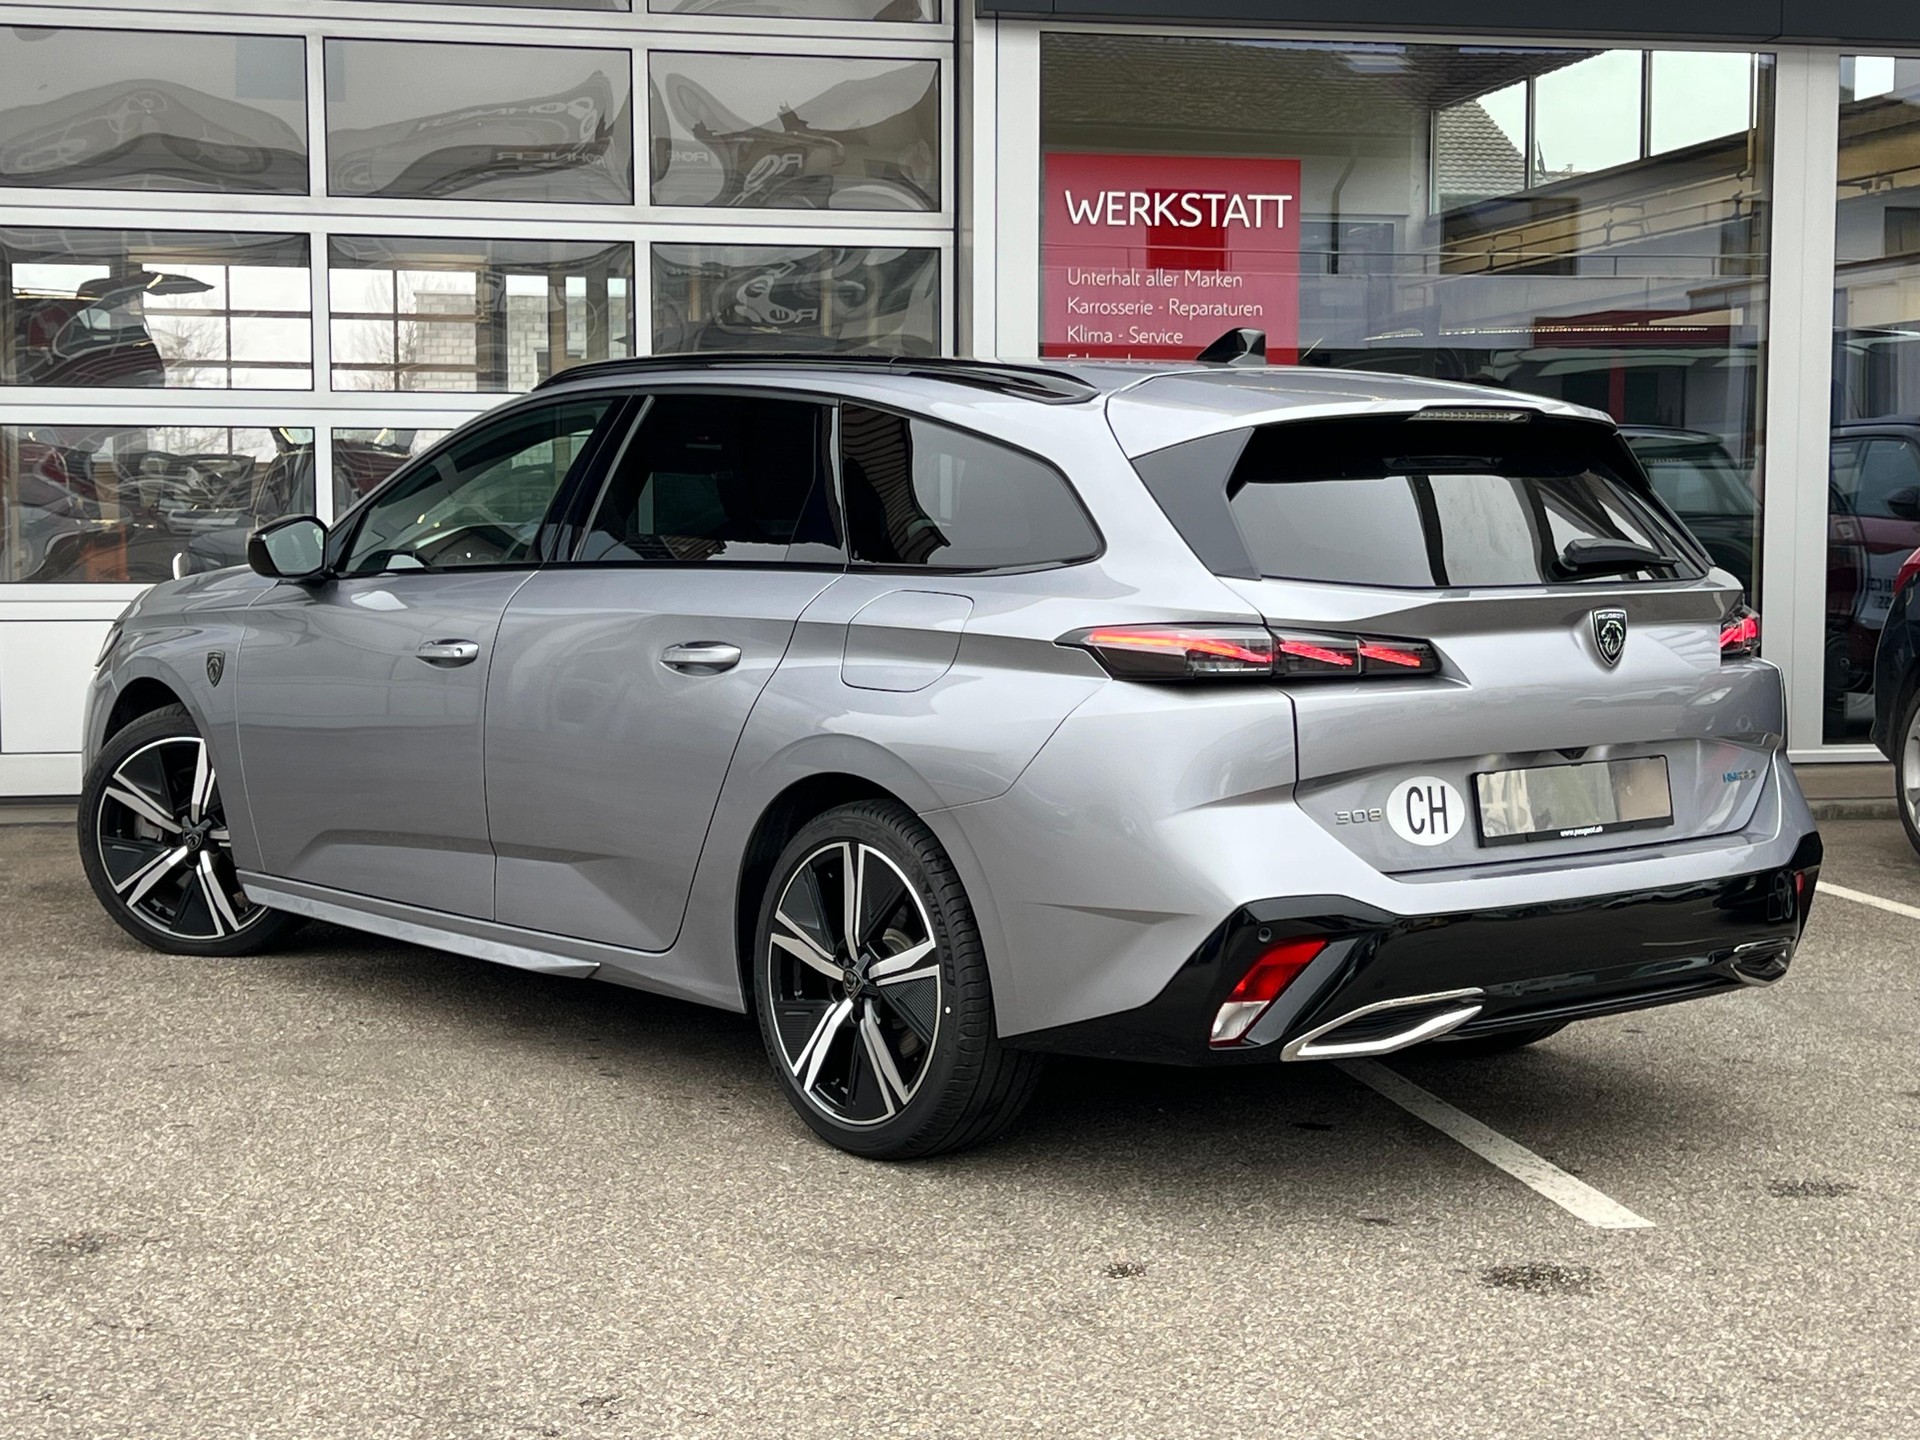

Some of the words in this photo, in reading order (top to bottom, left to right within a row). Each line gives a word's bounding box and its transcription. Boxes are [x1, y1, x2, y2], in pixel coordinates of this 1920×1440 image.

[1065, 189, 1293, 228] WERKSTATT
[1067, 268, 1141, 287] Unterhalt
[1145, 269, 1179, 287] aller
[1184, 269, 1243, 288] Marken
[1067, 297, 1154, 316] Karrosserie
[1169, 298, 1263, 320] Reparaturen
[1067, 325, 1113, 343] Klima
[1128, 326, 1184, 344] Service
[1335, 807, 1382, 825] 308
[1405, 785, 1449, 835] CH
